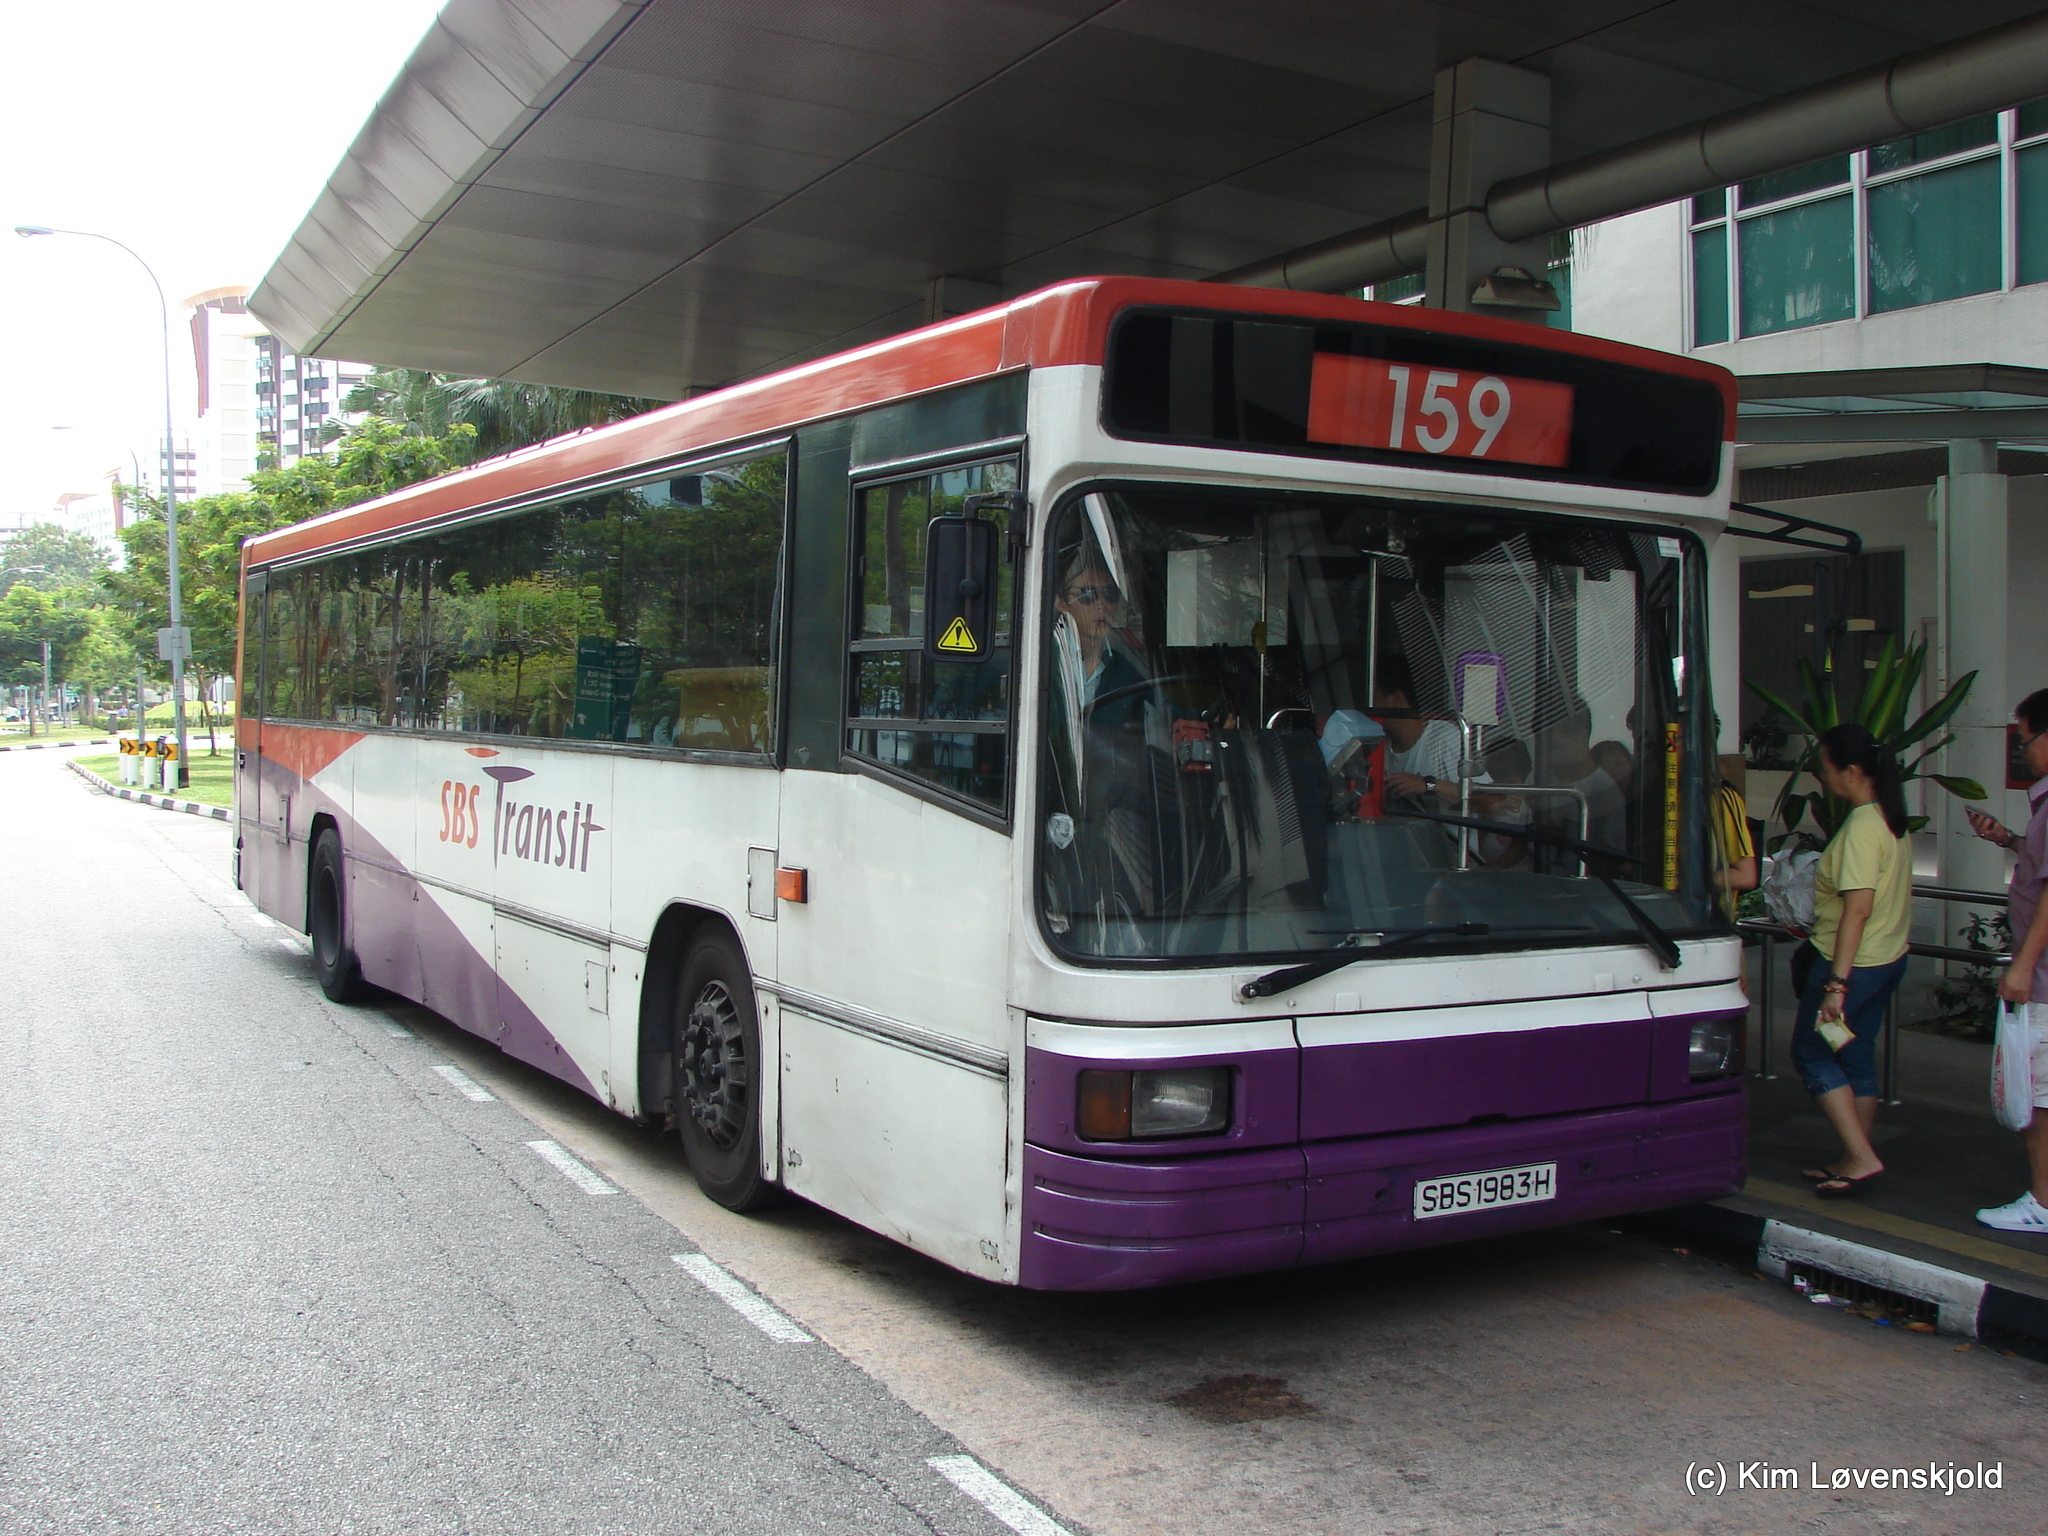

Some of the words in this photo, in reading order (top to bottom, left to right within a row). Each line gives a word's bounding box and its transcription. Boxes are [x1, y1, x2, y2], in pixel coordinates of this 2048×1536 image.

[1388, 365, 1511, 456] 159
[439, 780, 480, 849] SBS
[481, 766, 606, 872] Transit
[1422, 1168, 1551, 1212] SBS1983H
